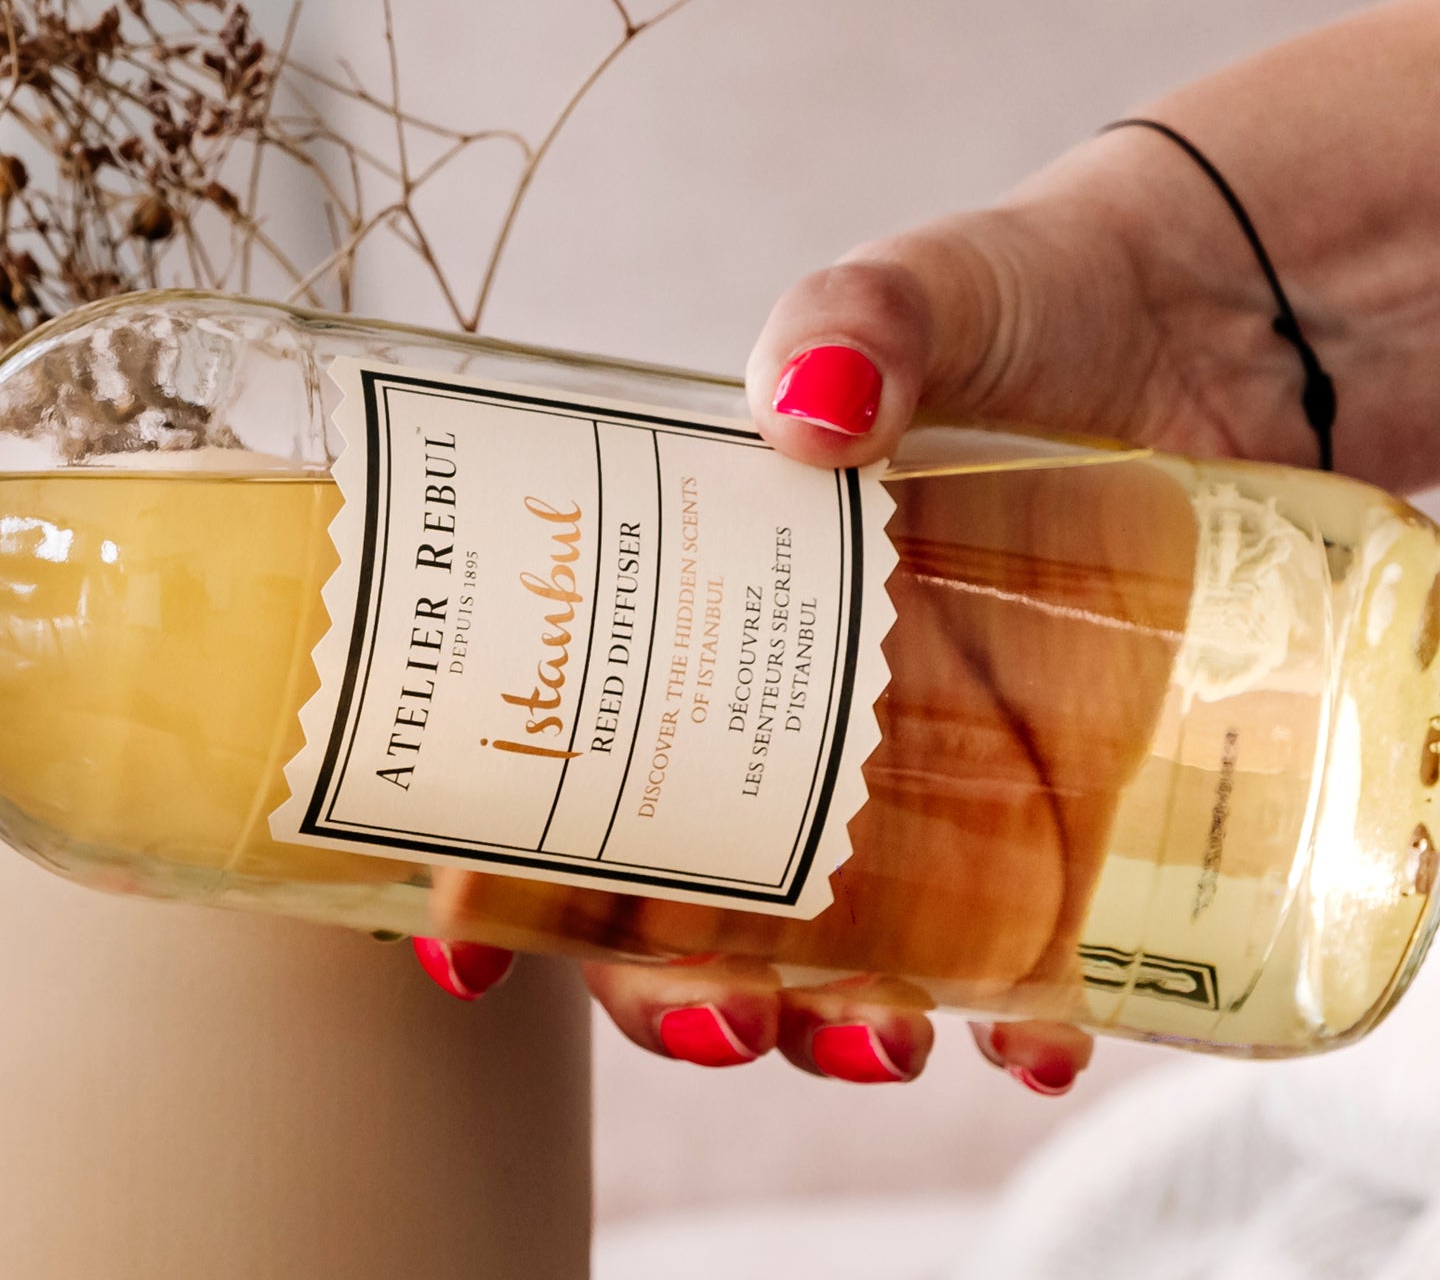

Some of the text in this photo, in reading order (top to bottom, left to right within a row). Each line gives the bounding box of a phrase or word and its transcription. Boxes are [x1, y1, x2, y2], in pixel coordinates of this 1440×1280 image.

[376, 431, 458, 792] ATELIER REBUL
[449, 550, 479, 676] DEPUIS 1895
[591, 521, 641, 756] REED DIFFUSER
[637, 476, 699, 819] DISCOVER THE HIDDEN SCENTS
[691, 575, 724, 724] OF ISTANBUL
[728, 585, 763, 734] DÉCOUVREZ
[742, 525, 792, 797] LES SENTEURS SECRÈTES
